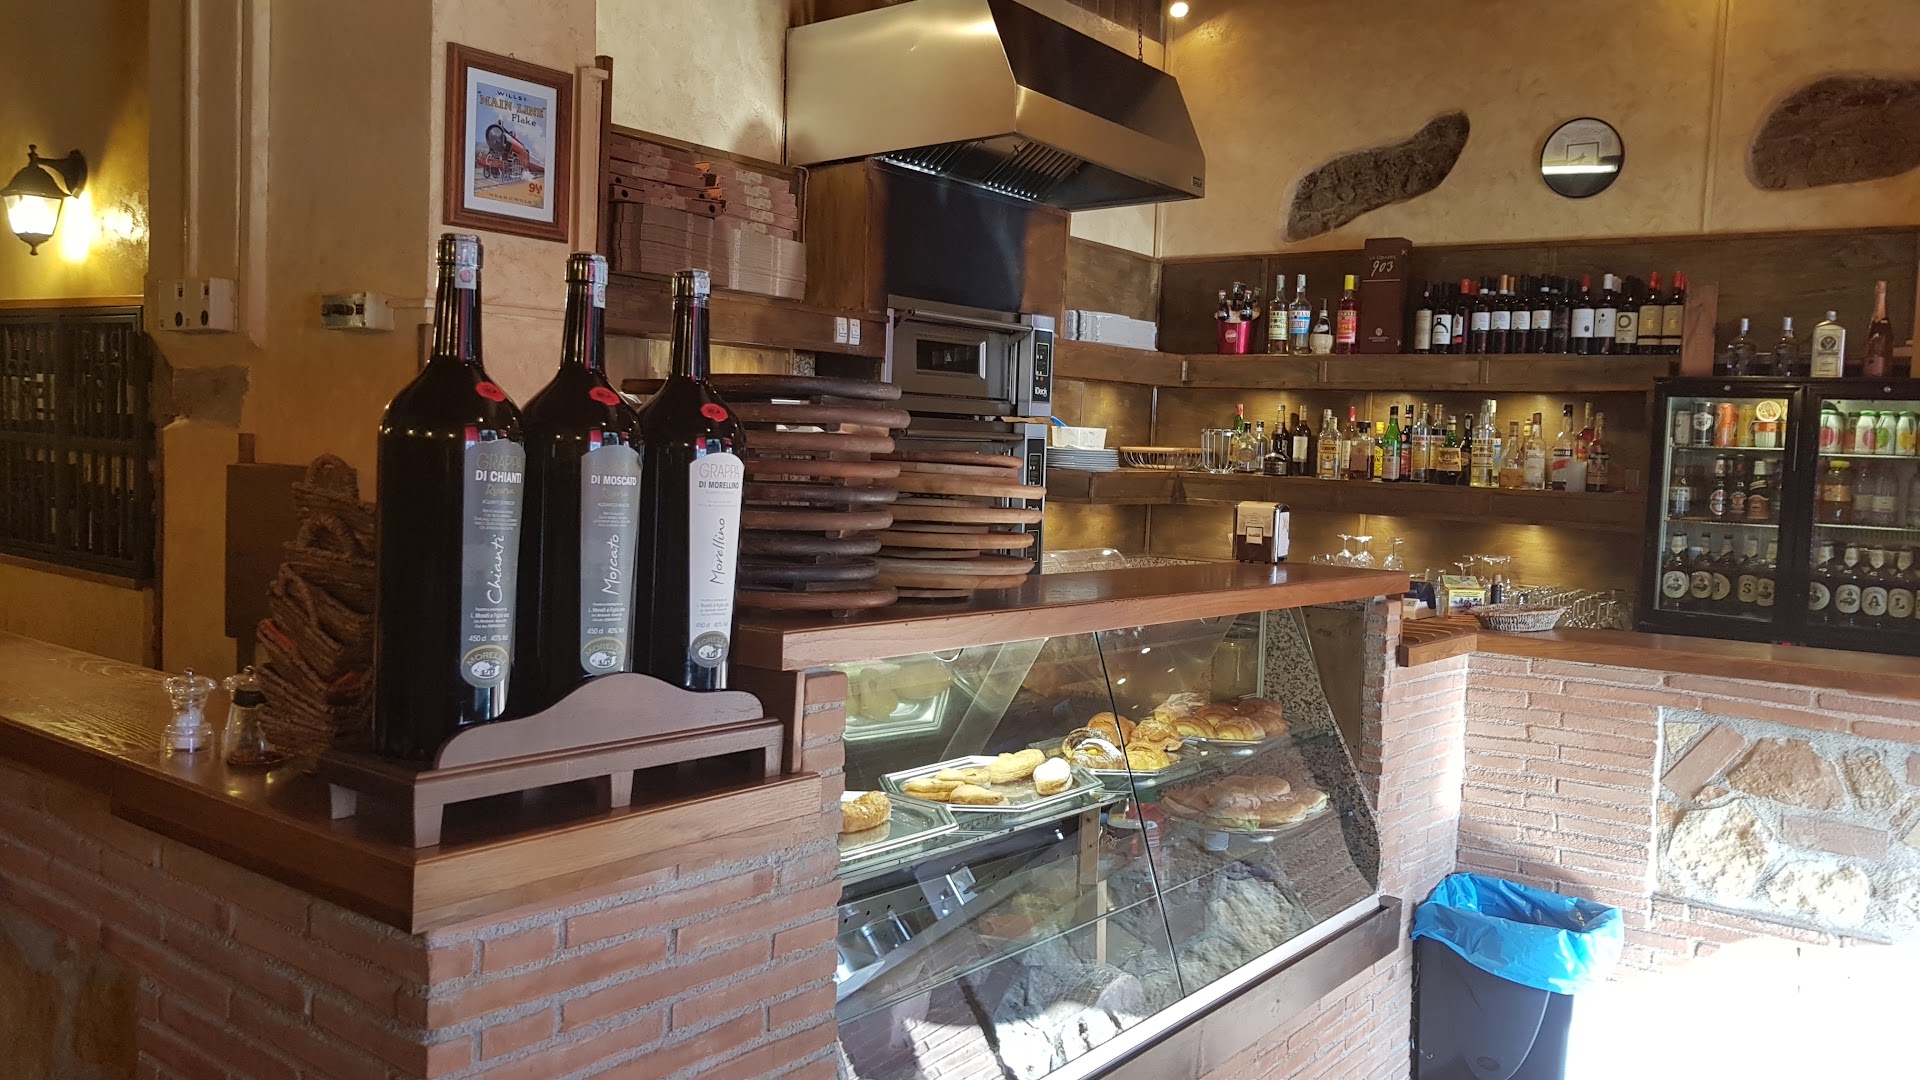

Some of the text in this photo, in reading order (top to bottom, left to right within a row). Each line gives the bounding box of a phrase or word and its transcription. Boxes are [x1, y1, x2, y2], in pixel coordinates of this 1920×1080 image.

[511, 113, 537, 127] Flake
[1371, 260, 1394, 277] 903
[477, 453, 522, 470] GRAPPA
[475, 469, 522, 483] DI CHIANTI
[699, 462, 740, 479] GRAPPA
[590, 474, 637, 486] DI MOSCATO
[708, 481, 740, 489] MORELLINO
[709, 517, 726, 585] Morellino
[486, 534, 505, 604] Chianti
[601, 534, 622, 595] Moscato
[1867, 595, 1881, 607] A
[468, 634, 481, 642] 450
[585, 643, 623, 656] MORELLI
[466, 651, 507, 666] MORELLI
